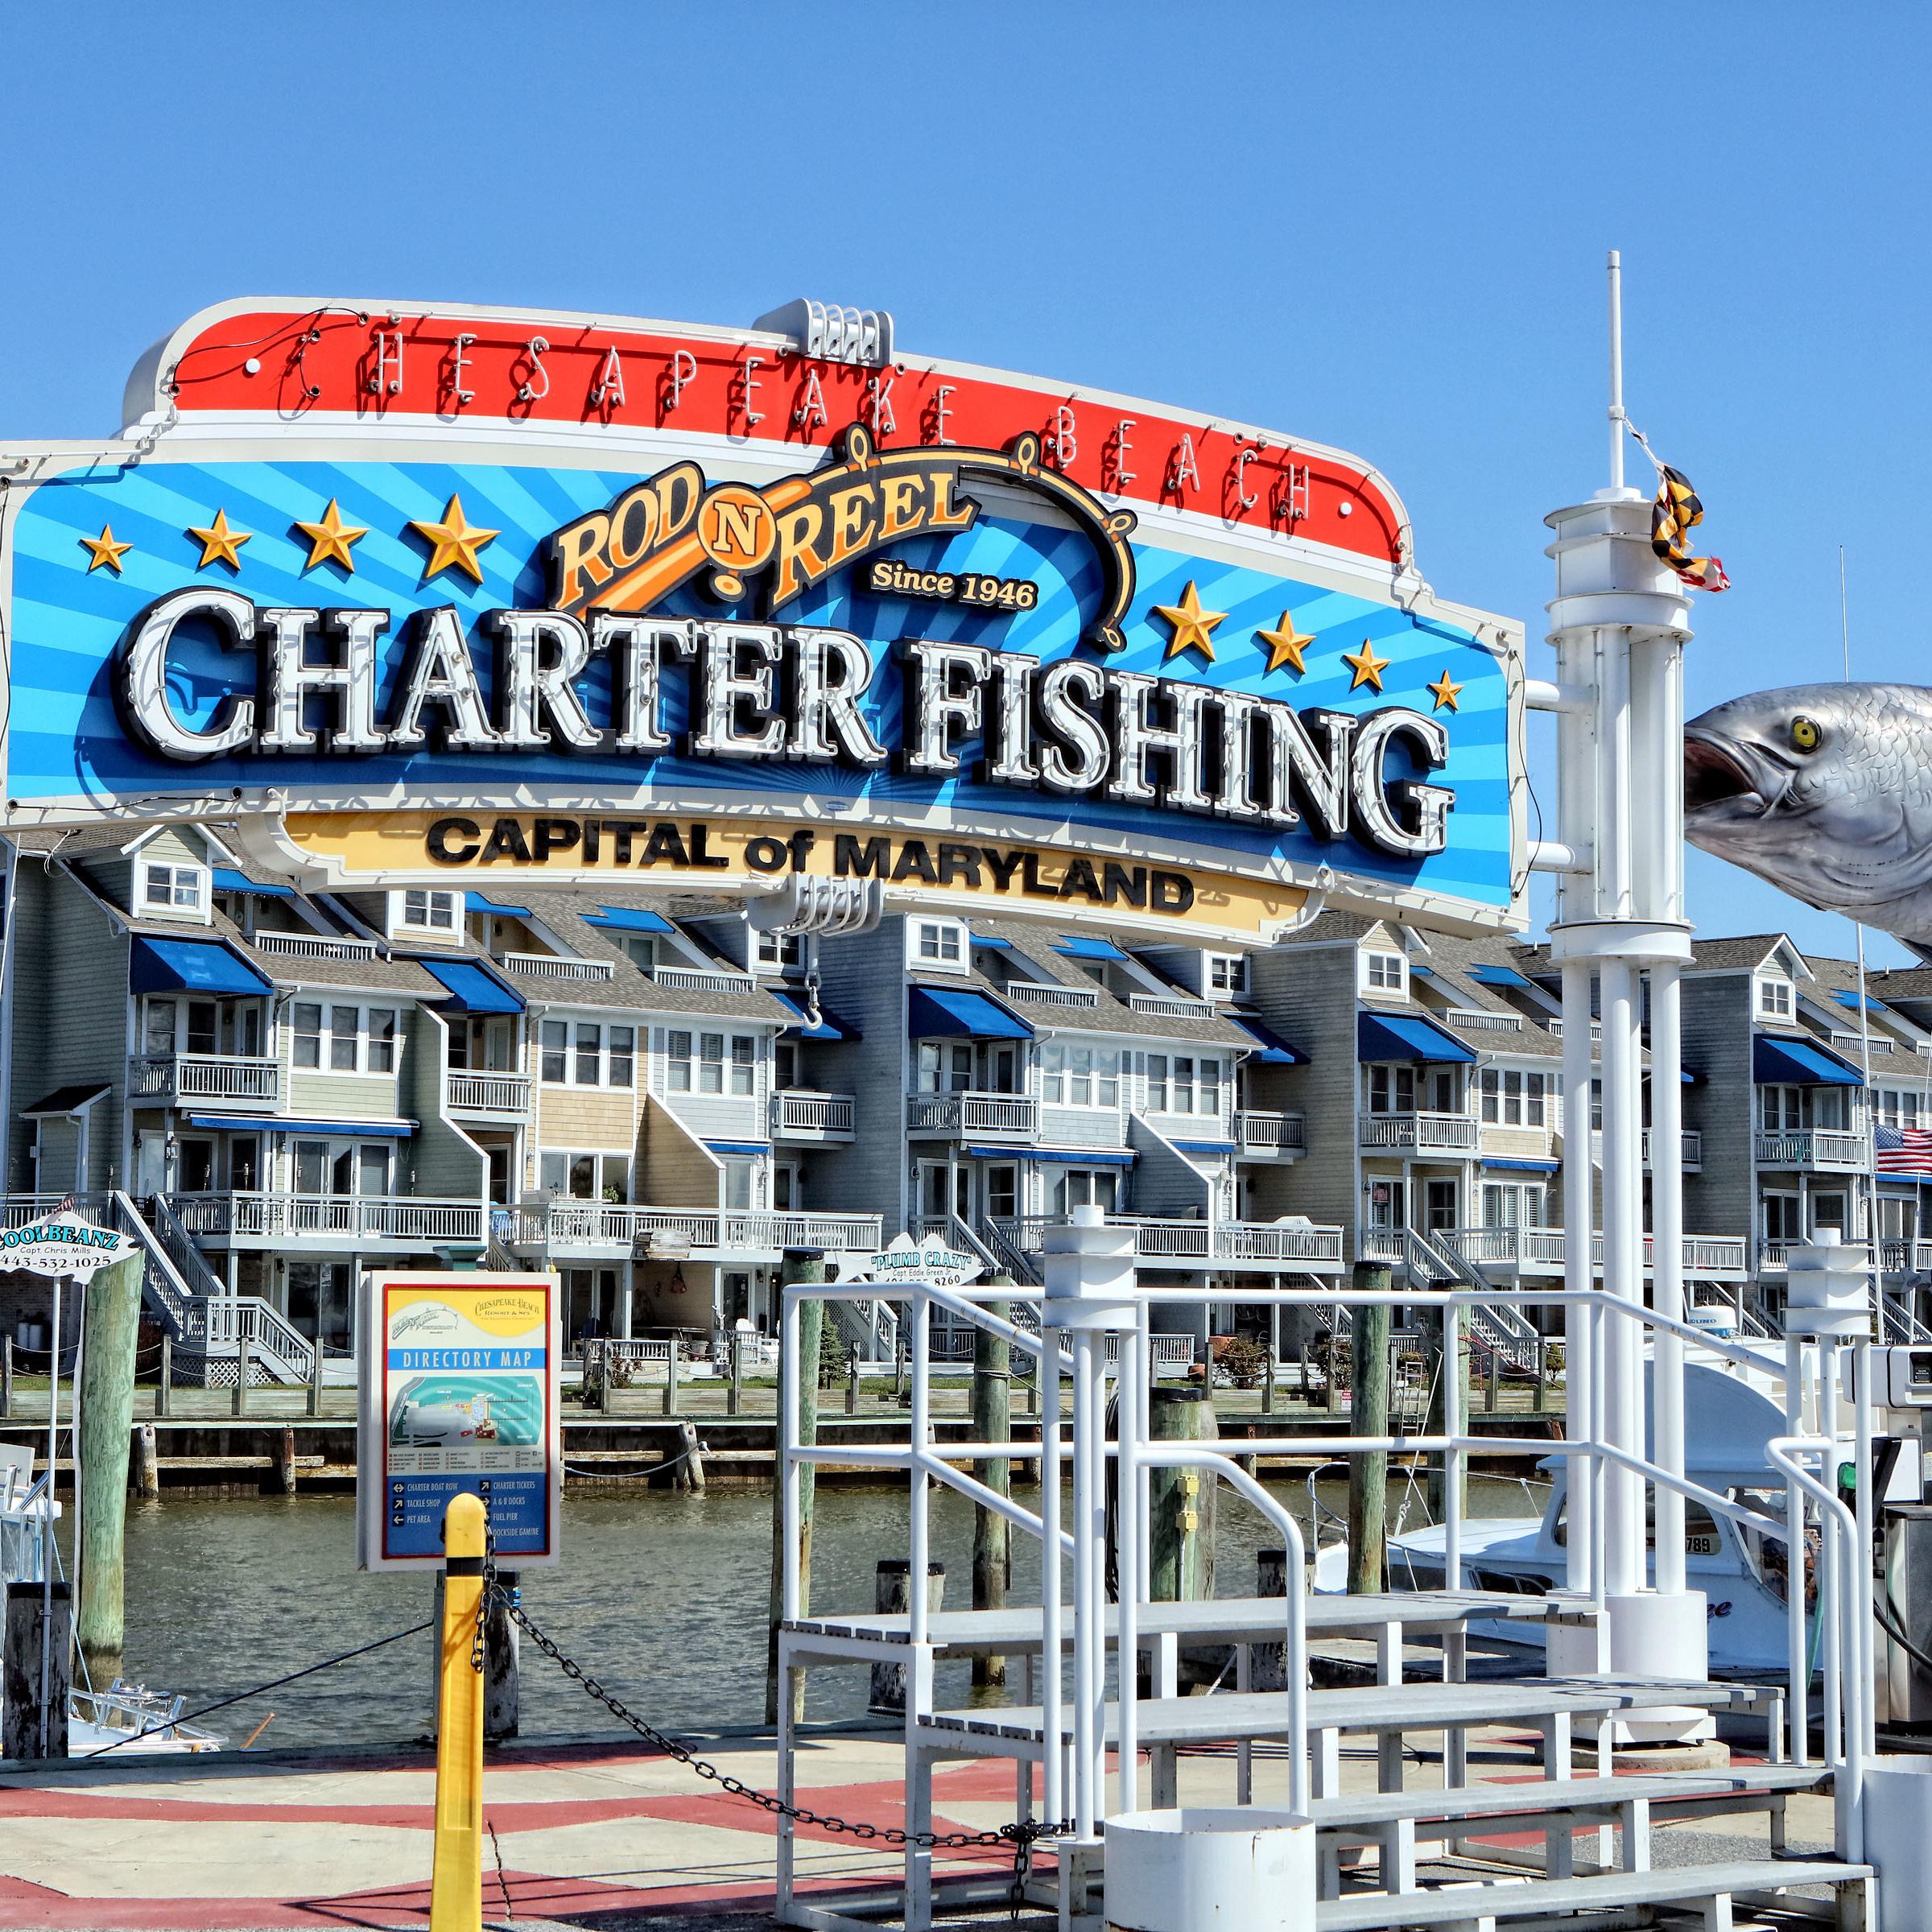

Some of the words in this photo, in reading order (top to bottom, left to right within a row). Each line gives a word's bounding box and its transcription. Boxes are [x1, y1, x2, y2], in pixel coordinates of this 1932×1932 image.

[296, 330, 958, 446] HESAPEAKE
[1049, 405, 1310, 520] BEACH
[555, 465, 700, 609] ROD
[712, 502, 762, 556] N
[772, 472, 974, 606] REEL
[872, 563, 955, 595] Since
[962, 577, 1034, 608] 1946
[122, 588, 887, 763] CHARTER
[910, 639, 1455, 855] FISHING
[427, 817, 730, 868] CAPITAL
[745, 829, 815, 873] of
[834, 834, 1195, 912] MARYLAND
[0, 1254, 111, 1269] 443-532-1025
[871, 1252, 921, 1271] "PLUMB
[925, 1252, 972, 1270] CRAZY"
[403, 1352, 492, 1368] DIRECTORY
[501, 1352, 531, 1367] MAP
[407, 1484, 430, 1492] CHARTER
[431, 1483, 444, 1491] BOAT
[493, 1481, 515, 1489] CHARTER
[516, 1480, 535, 1489] TICKETS
[407, 1500, 426, 1508] TACKLE
[426, 1499, 440, 1507] SHOP
[493, 1497, 497, 1505] A
[497, 1497, 503, 1505] &
[407, 1515, 416, 1524] PET
[416, 1515, 431, 1523] AREA
[493, 1528, 518, 1537] DOCKSIDE
[1685, 1537, 1711, 1553] 789
